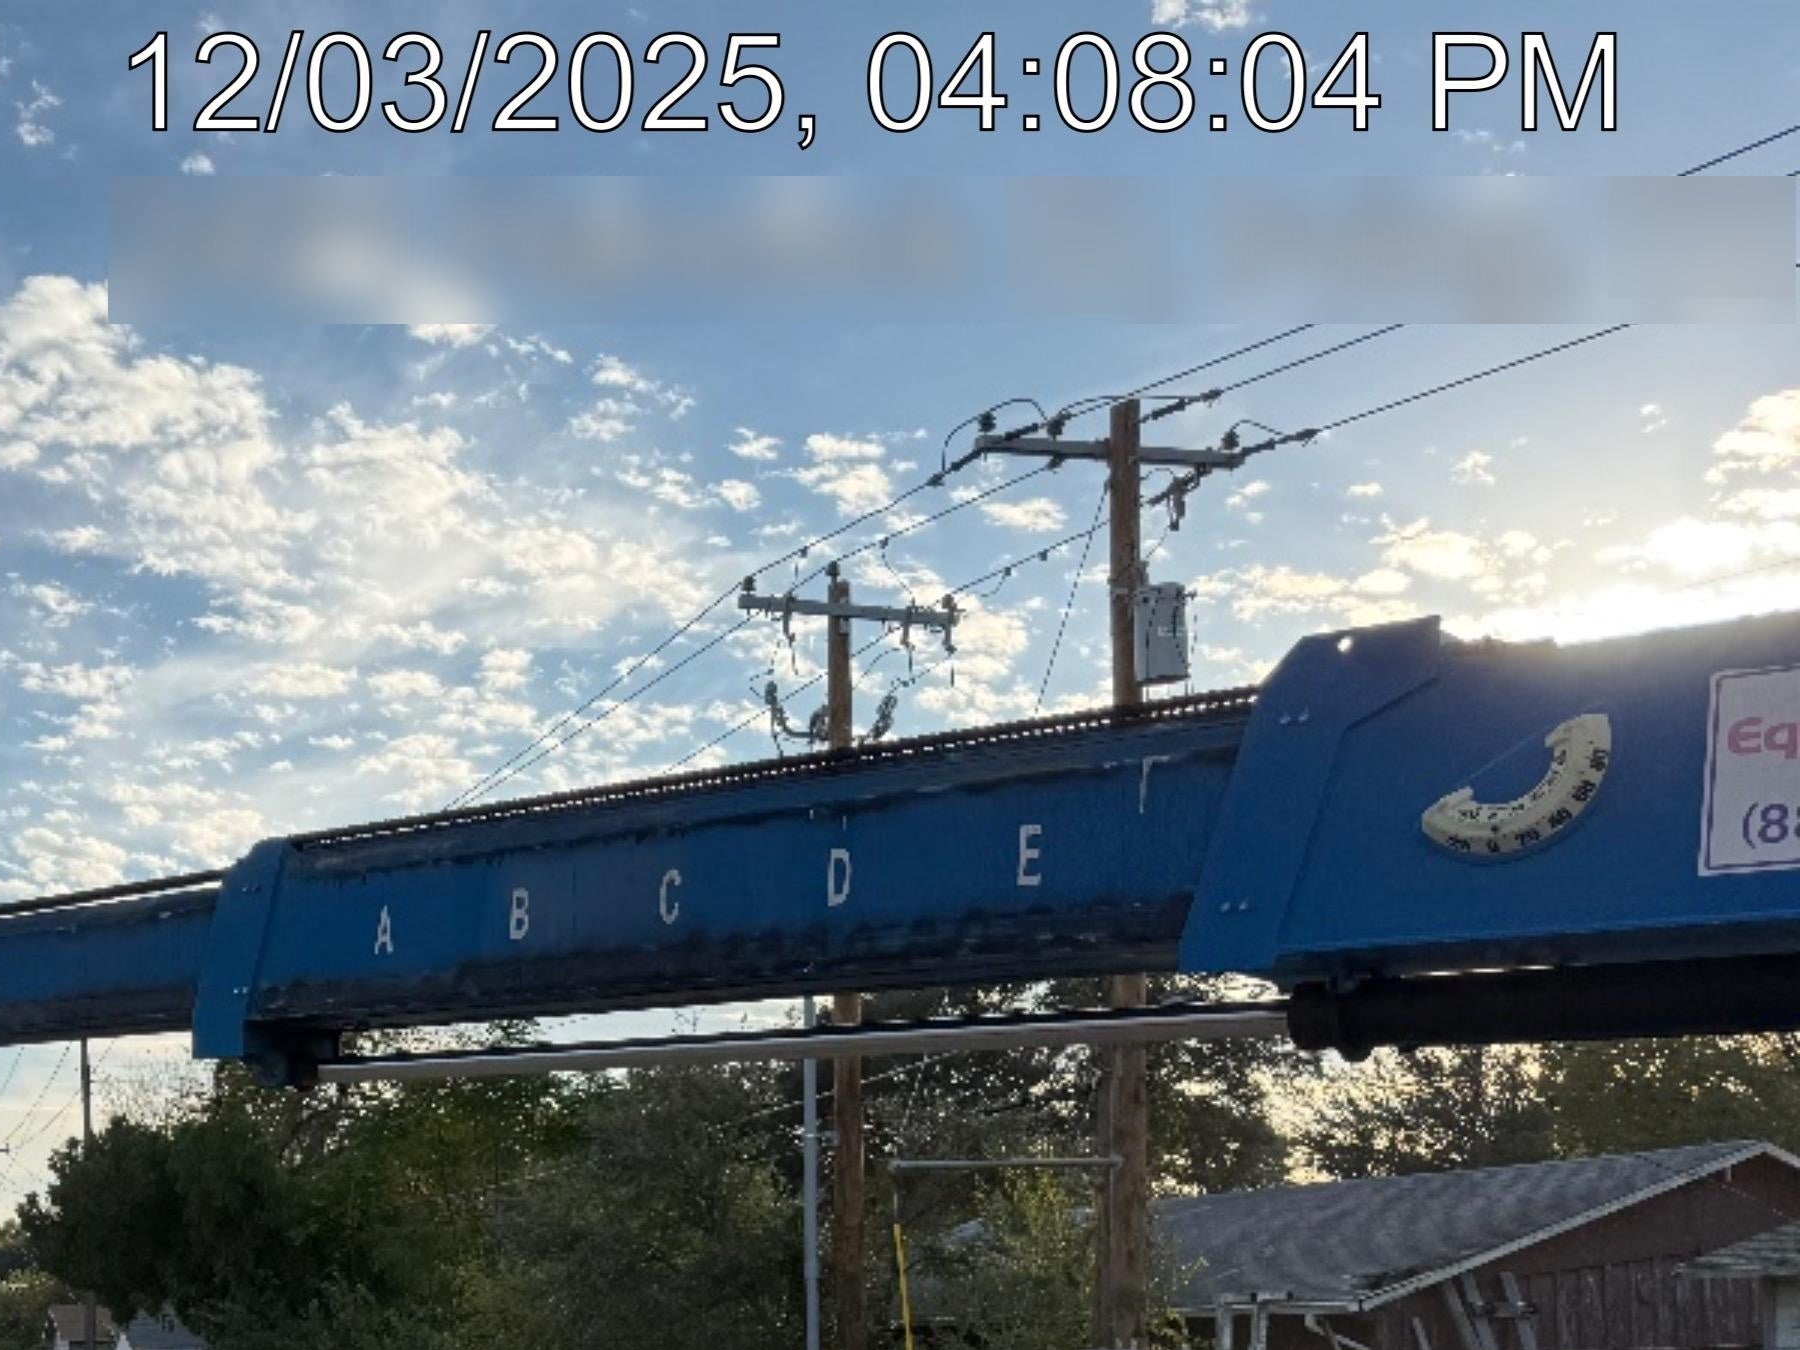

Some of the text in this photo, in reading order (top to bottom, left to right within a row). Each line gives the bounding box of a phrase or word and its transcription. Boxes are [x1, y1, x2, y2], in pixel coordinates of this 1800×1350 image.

[1742, 802, 1800, 850] (8
[373, 823, 1043, 955] A B C D E
